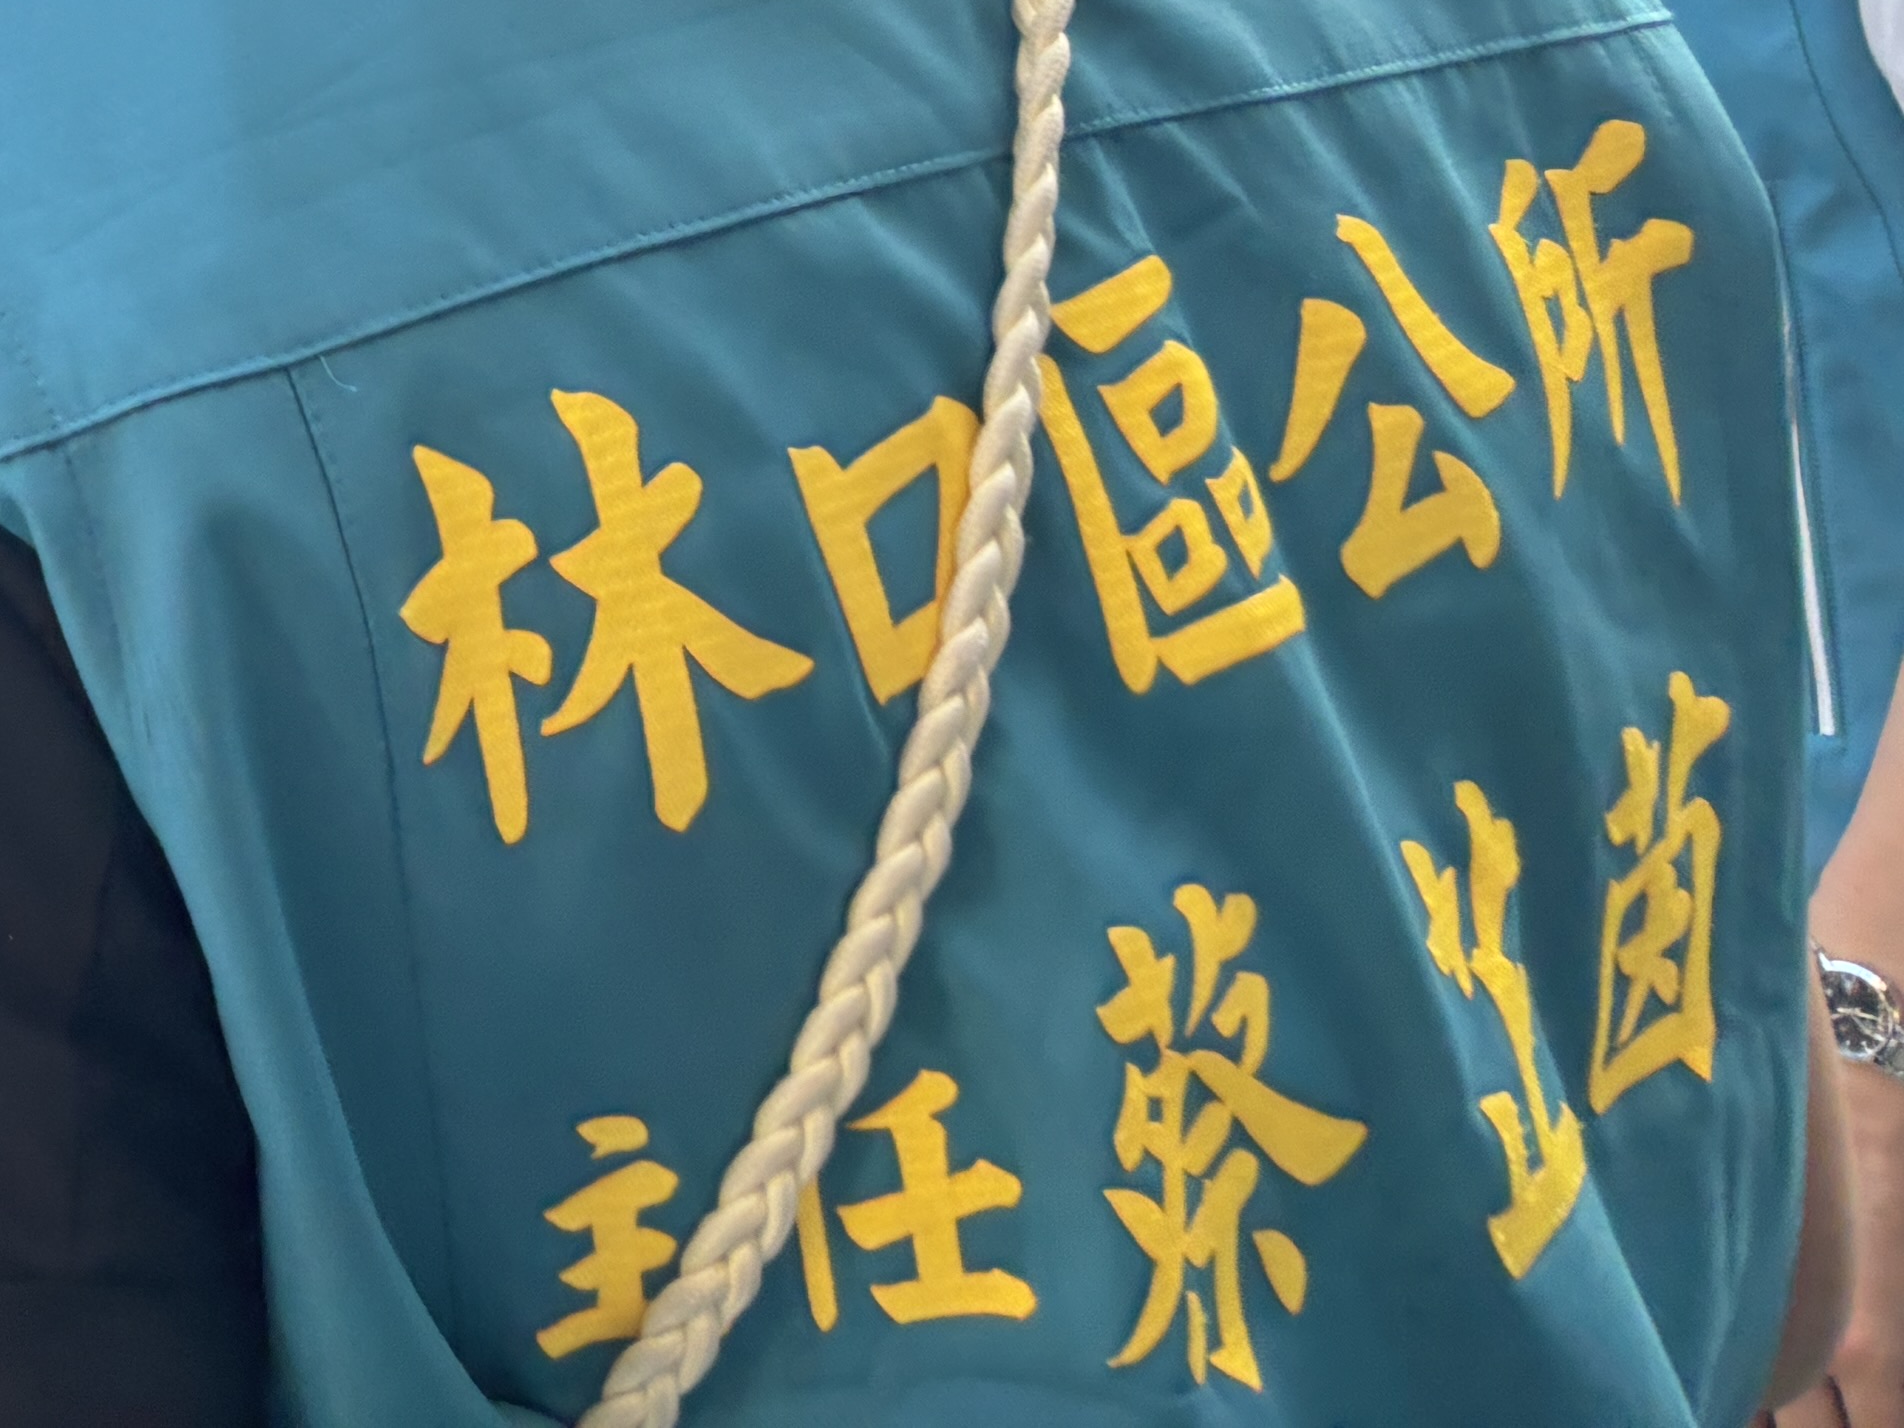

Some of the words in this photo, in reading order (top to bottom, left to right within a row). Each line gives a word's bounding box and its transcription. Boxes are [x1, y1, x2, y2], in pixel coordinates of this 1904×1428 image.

[398, 119, 1693, 846] 林口區公所
